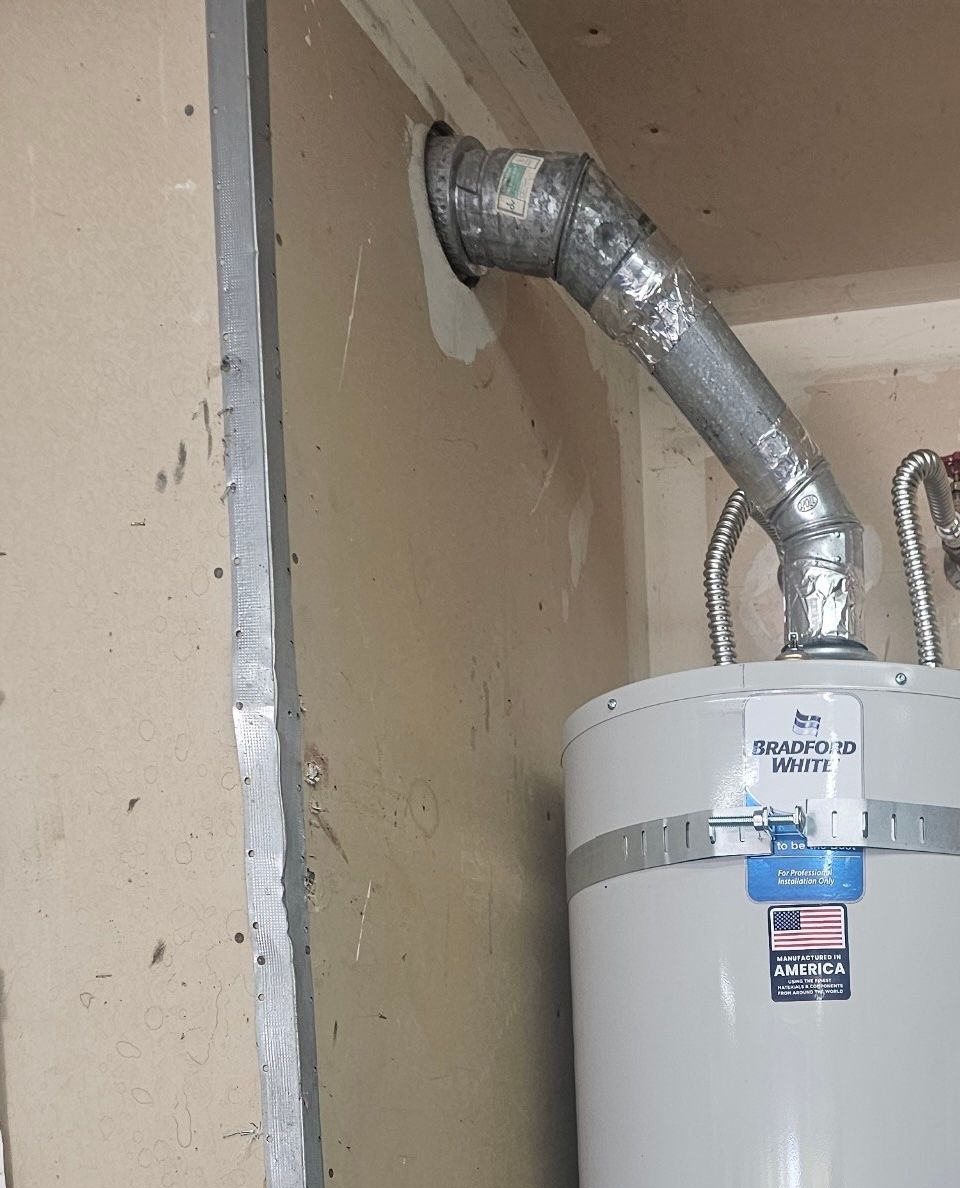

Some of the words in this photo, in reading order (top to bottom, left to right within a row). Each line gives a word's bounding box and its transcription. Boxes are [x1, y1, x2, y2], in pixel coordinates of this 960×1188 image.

[752, 740, 856, 755] BRADFORD
[772, 757, 840, 773] WHITE
[777, 841, 788, 850] to
[791, 841, 805, 850] be
[778, 869, 789, 877] For
[791, 868, 832, 877] Professional
[819, 877, 834, 885] Only
[774, 963, 845, 976] AMERICA
